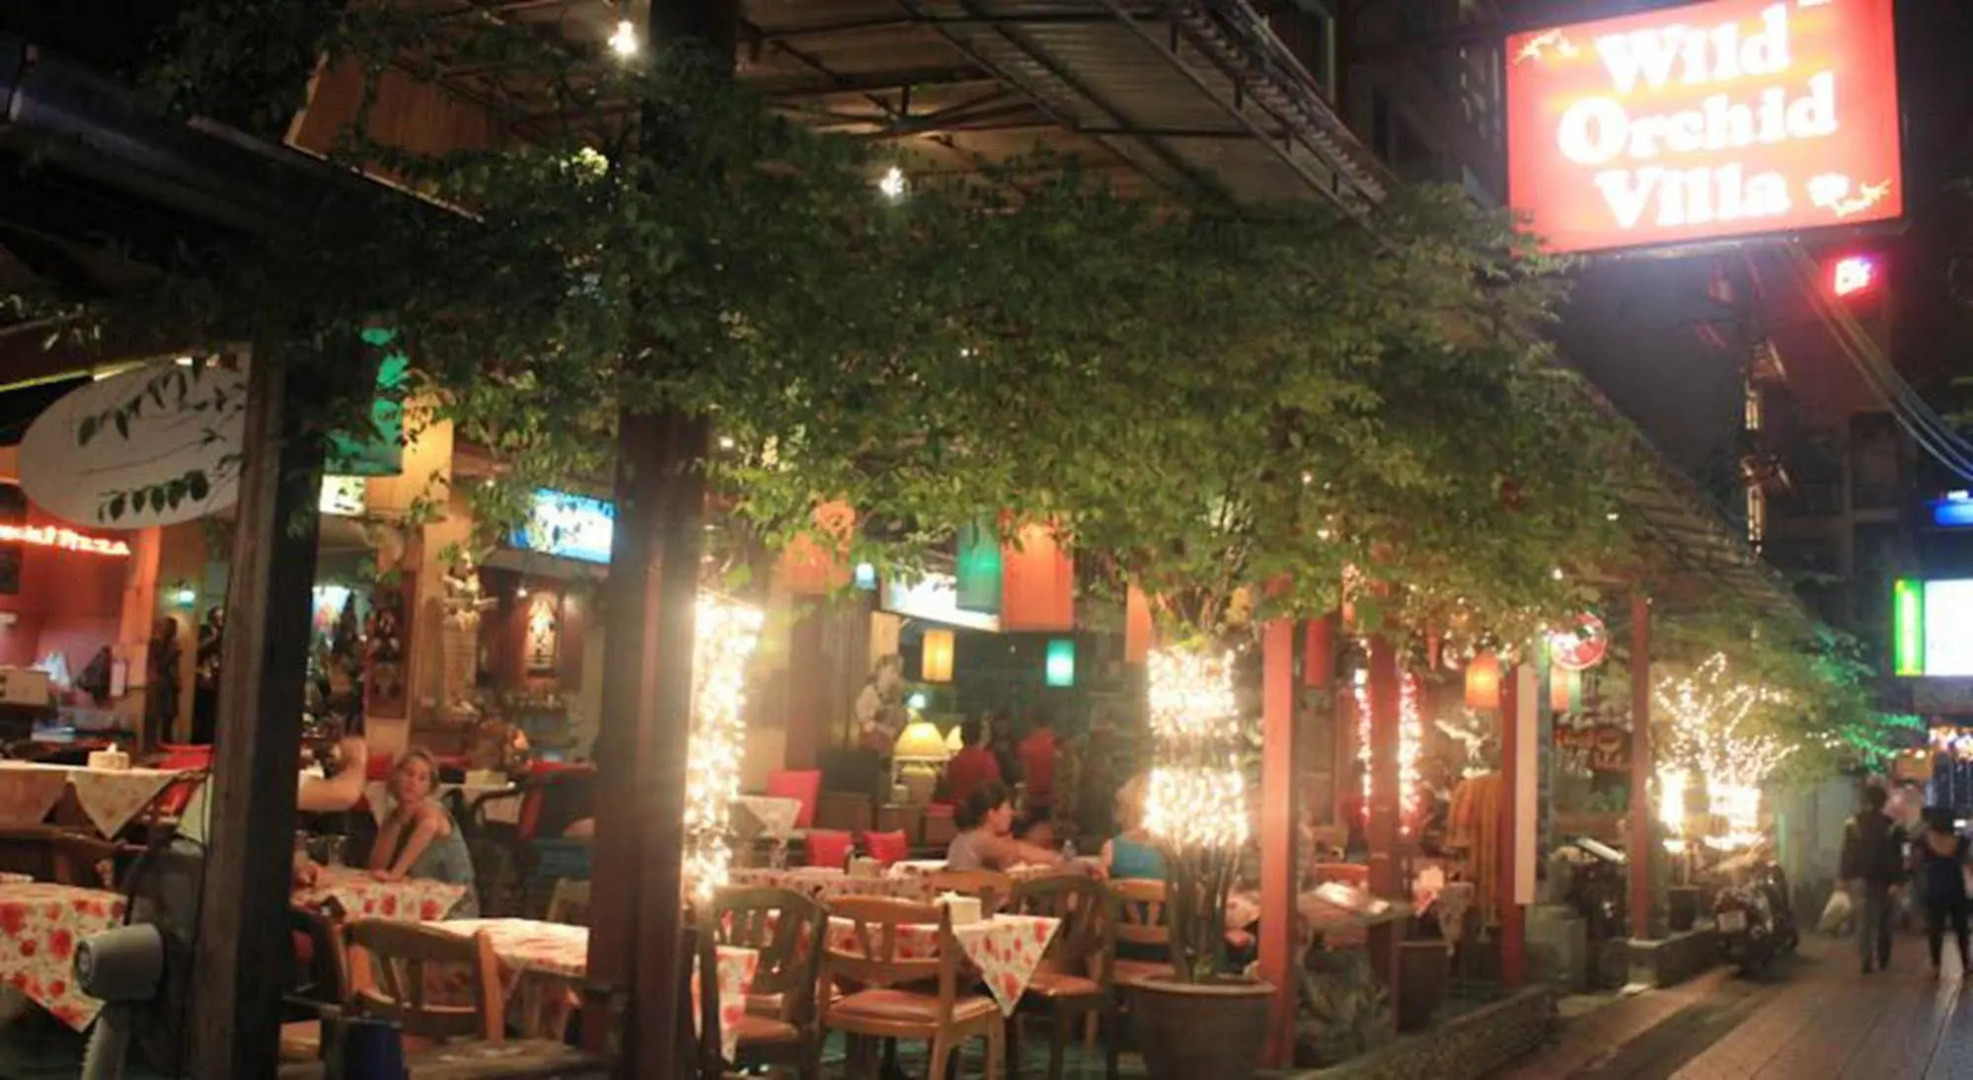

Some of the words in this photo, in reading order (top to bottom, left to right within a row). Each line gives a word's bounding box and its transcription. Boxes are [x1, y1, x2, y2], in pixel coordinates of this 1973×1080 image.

[1594, 5, 1790, 94] Wild
[1557, 70, 1839, 165] Orchid
[1595, 162, 1790, 229] Villa
